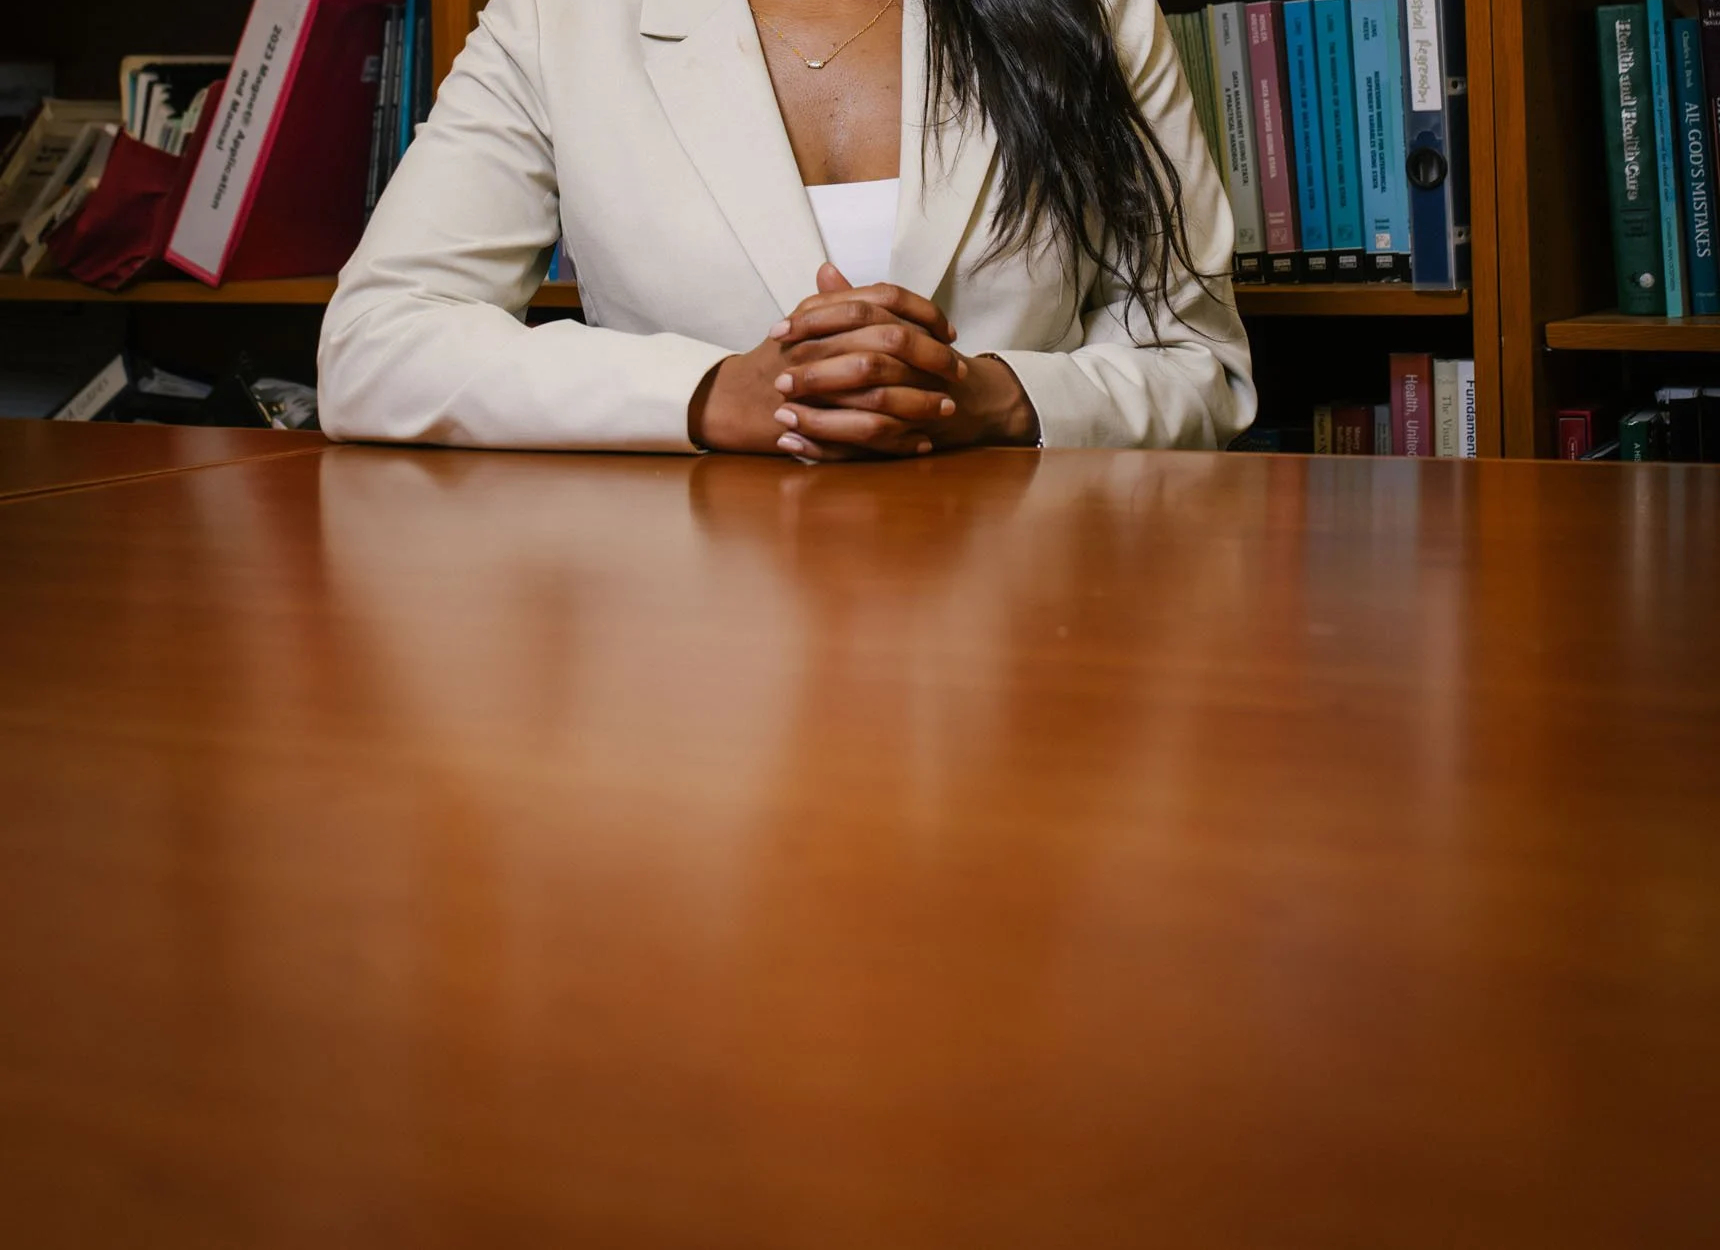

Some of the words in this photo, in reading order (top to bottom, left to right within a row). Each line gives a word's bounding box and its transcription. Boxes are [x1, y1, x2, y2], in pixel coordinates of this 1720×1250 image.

[264, 24, 283, 60] 2023
[1221, 12, 1231, 46] MITCHELL
[1258, 14, 1268, 42] KOHLER
[1362, 17, 1370, 41] FREESE
[1370, 19, 1378, 38] LONG
[1296, 44, 1305, 57] THE
[1328, 41, 1336, 54] THE
[1615, 20, 1635, 75] Health
[235, 69, 249, 97] and
[1231, 70, 1240, 88] DATA
[1260, 79, 1269, 98] DATA
[1329, 55, 1339, 99] WORKFLOW
[1374, 71, 1382, 110] REGRESSION
[1619, 74, 1637, 107] and
[1300, 100, 1308, 110] OF
[1332, 100, 1340, 108] OF
[1366, 76, 1374, 113] DEPENDENT
[215, 100, 240, 151] Manual
[1225, 95, 1235, 132] PRACTICAL
[1233, 90, 1245, 139] MANAGEMENT
[1262, 99, 1273, 132] ANALYSIS
[1301, 111, 1310, 129] DATA
[1333, 110, 1341, 127] DATA
[1376, 112, 1384, 136] MODELS
[1684, 102, 1701, 126] ALL
[1265, 133, 1275, 155] USING
[1334, 128, 1343, 162] ANALYSIS
[1368, 114, 1376, 148] VARIABLES
[1620, 107, 1640, 162] Health
[1229, 133, 1238, 172] HANDBOOK
[1237, 140, 1246, 160] USING
[1688, 128, 1704, 178] GOD'S
[211, 130, 245, 210] Application
[1239, 161, 1249, 186] STATA:
[1267, 156, 1277, 179] STATA
[1336, 164, 1345, 185] USING
[1378, 152, 1387, 193] CATEGORICAL
[1625, 161, 1640, 201] Care
[1307, 188, 1316, 210] STATA
[1338, 187, 1346, 208] STATA
[1691, 181, 1711, 258] MISTAKES
[1404, 374, 1418, 416] Health,
[1441, 395, 1452, 415] The
[1442, 418, 1453, 449] Visual
